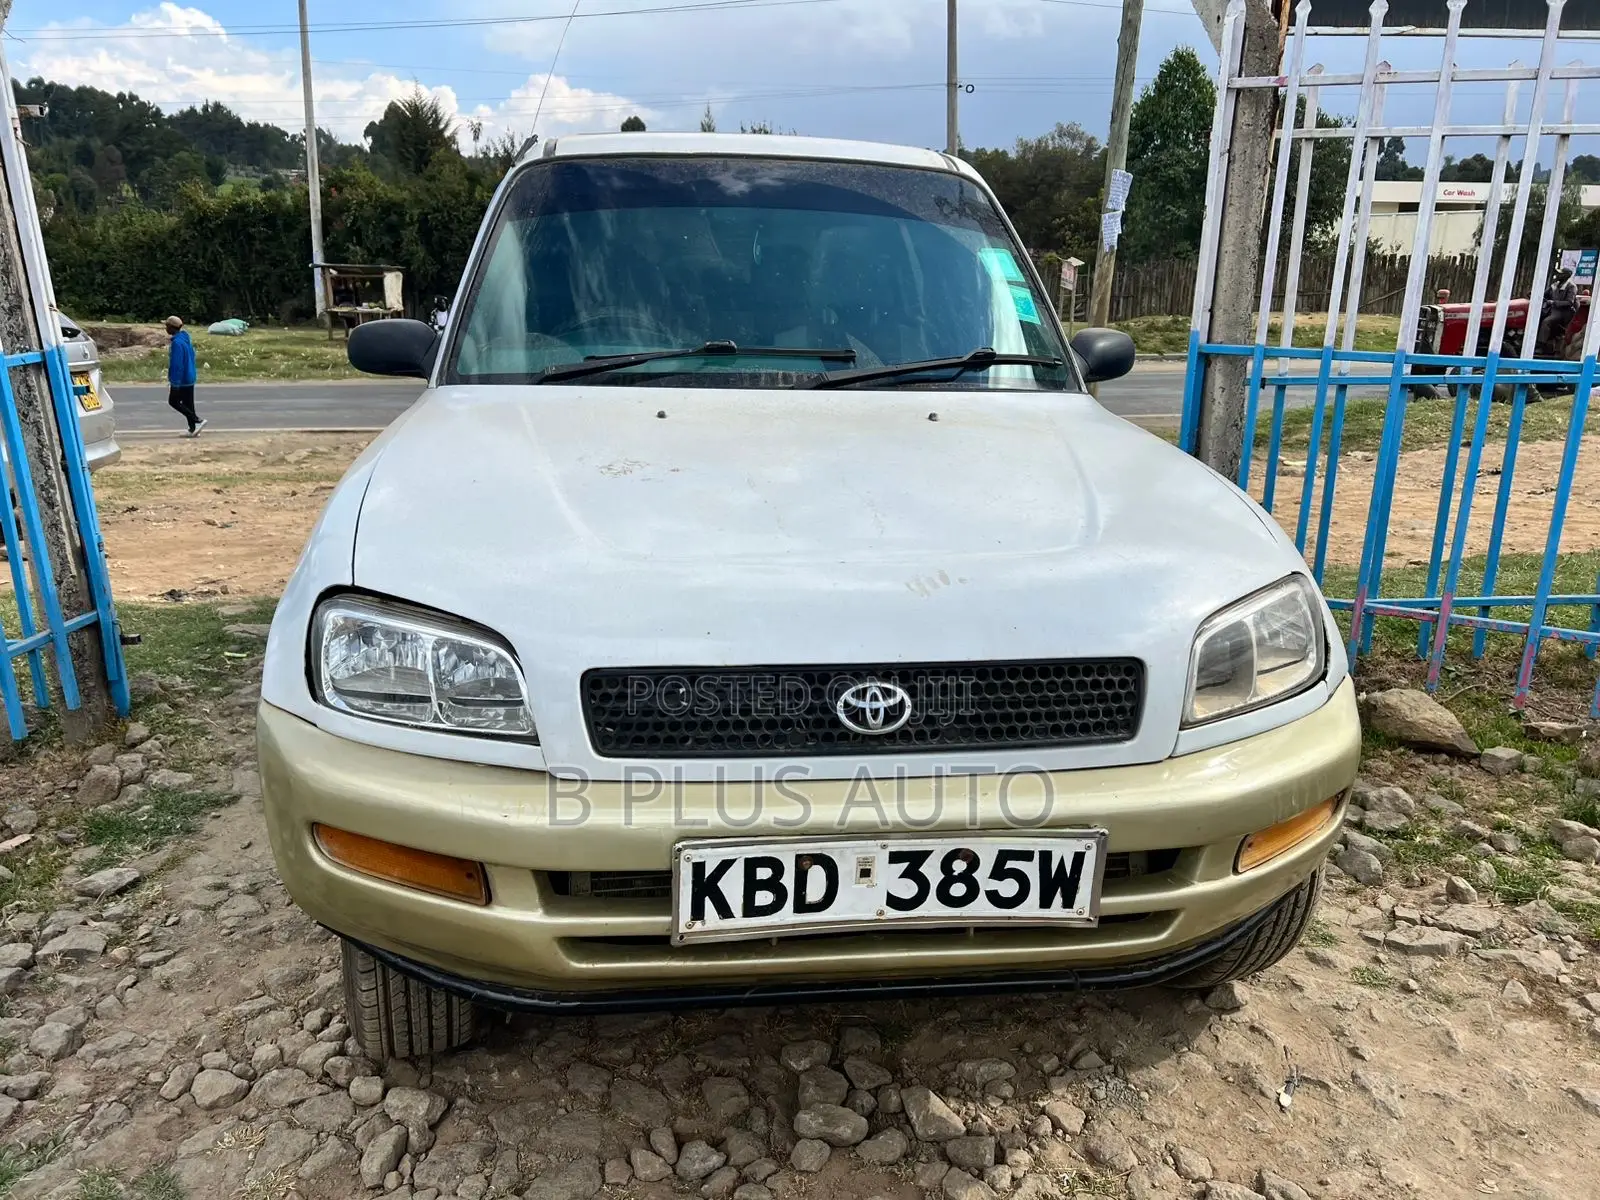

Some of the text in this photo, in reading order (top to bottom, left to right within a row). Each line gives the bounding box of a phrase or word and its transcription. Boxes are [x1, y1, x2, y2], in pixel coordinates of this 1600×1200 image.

[1443, 188, 1475, 197] Car Wash
[690, 847, 1088, 922] KBD 385W
